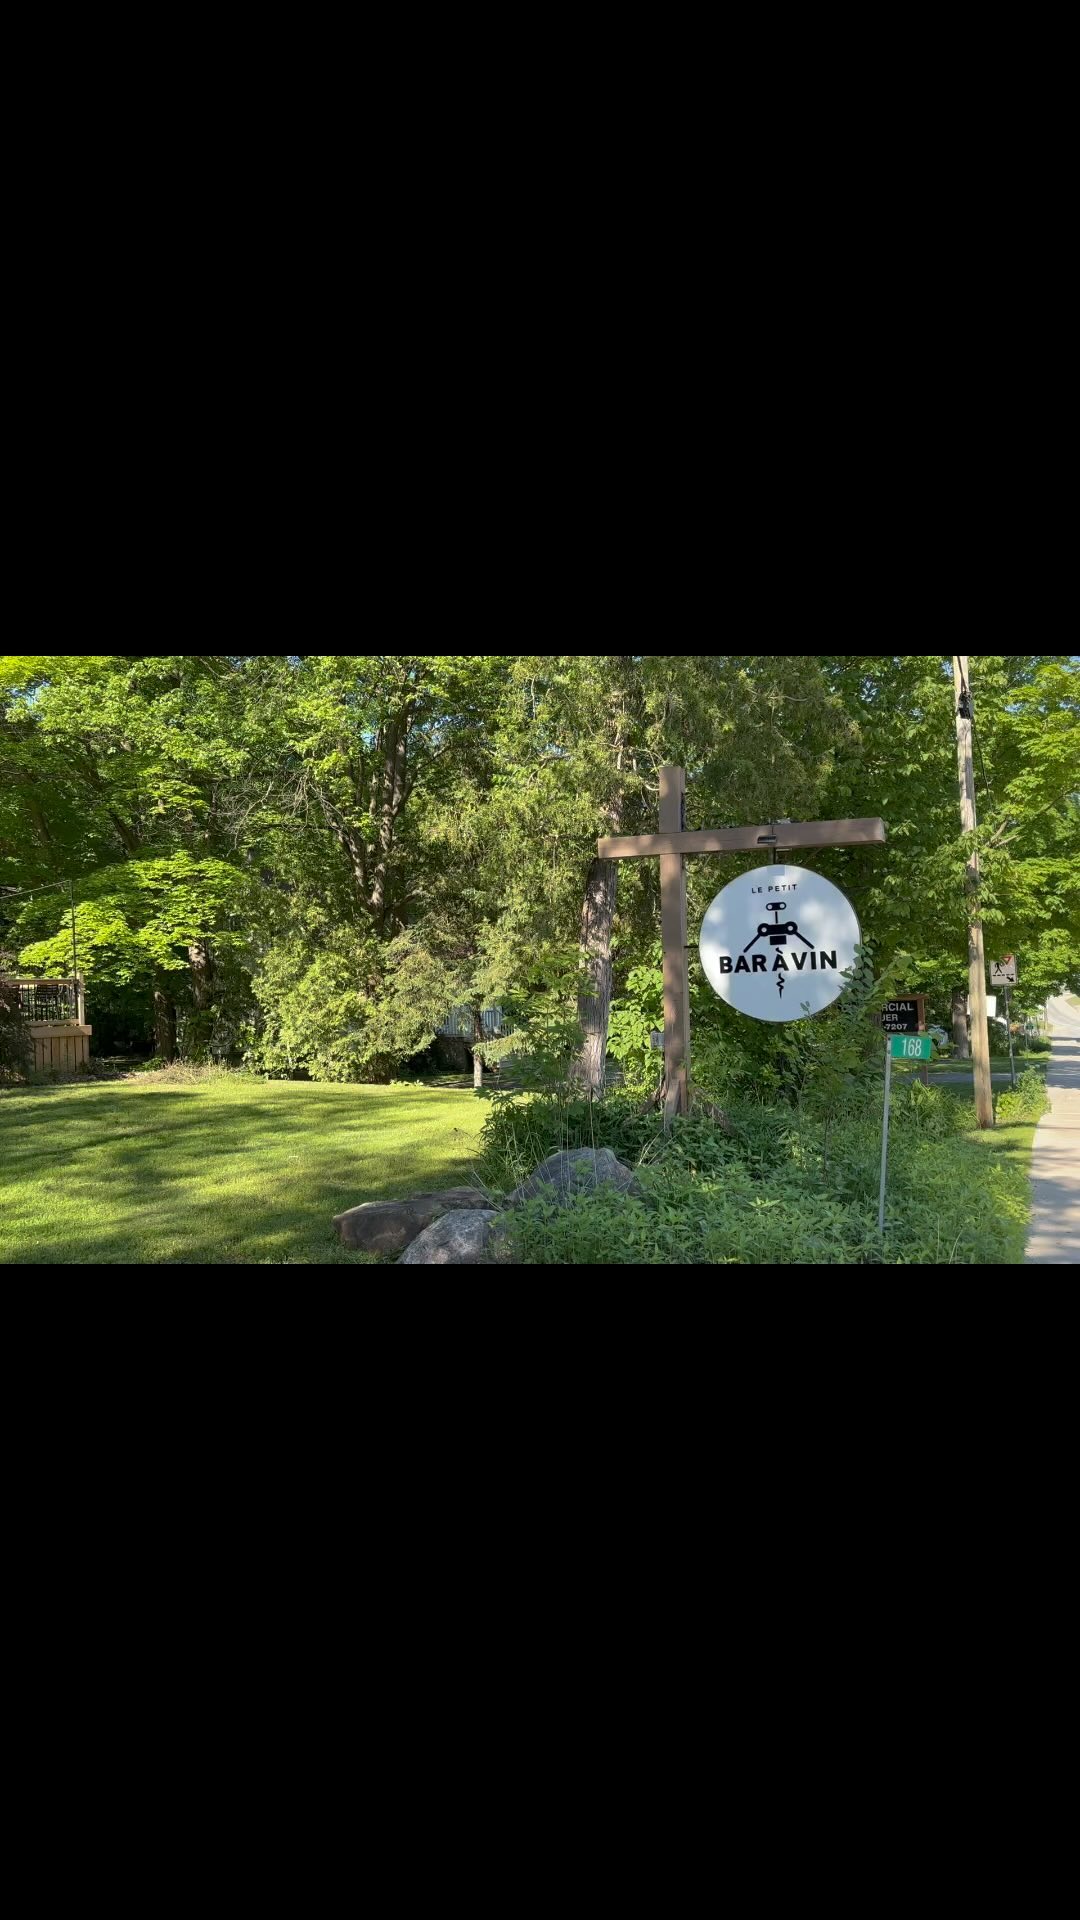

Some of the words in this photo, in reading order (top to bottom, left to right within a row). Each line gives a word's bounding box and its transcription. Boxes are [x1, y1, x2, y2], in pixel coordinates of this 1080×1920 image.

[751, 886, 763, 894] LE
[768, 884, 798, 892] PETIT
[719, 954, 767, 974] BAR
[791, 950, 837, 970] VIN
[902, 1038, 922, 1056] 168
